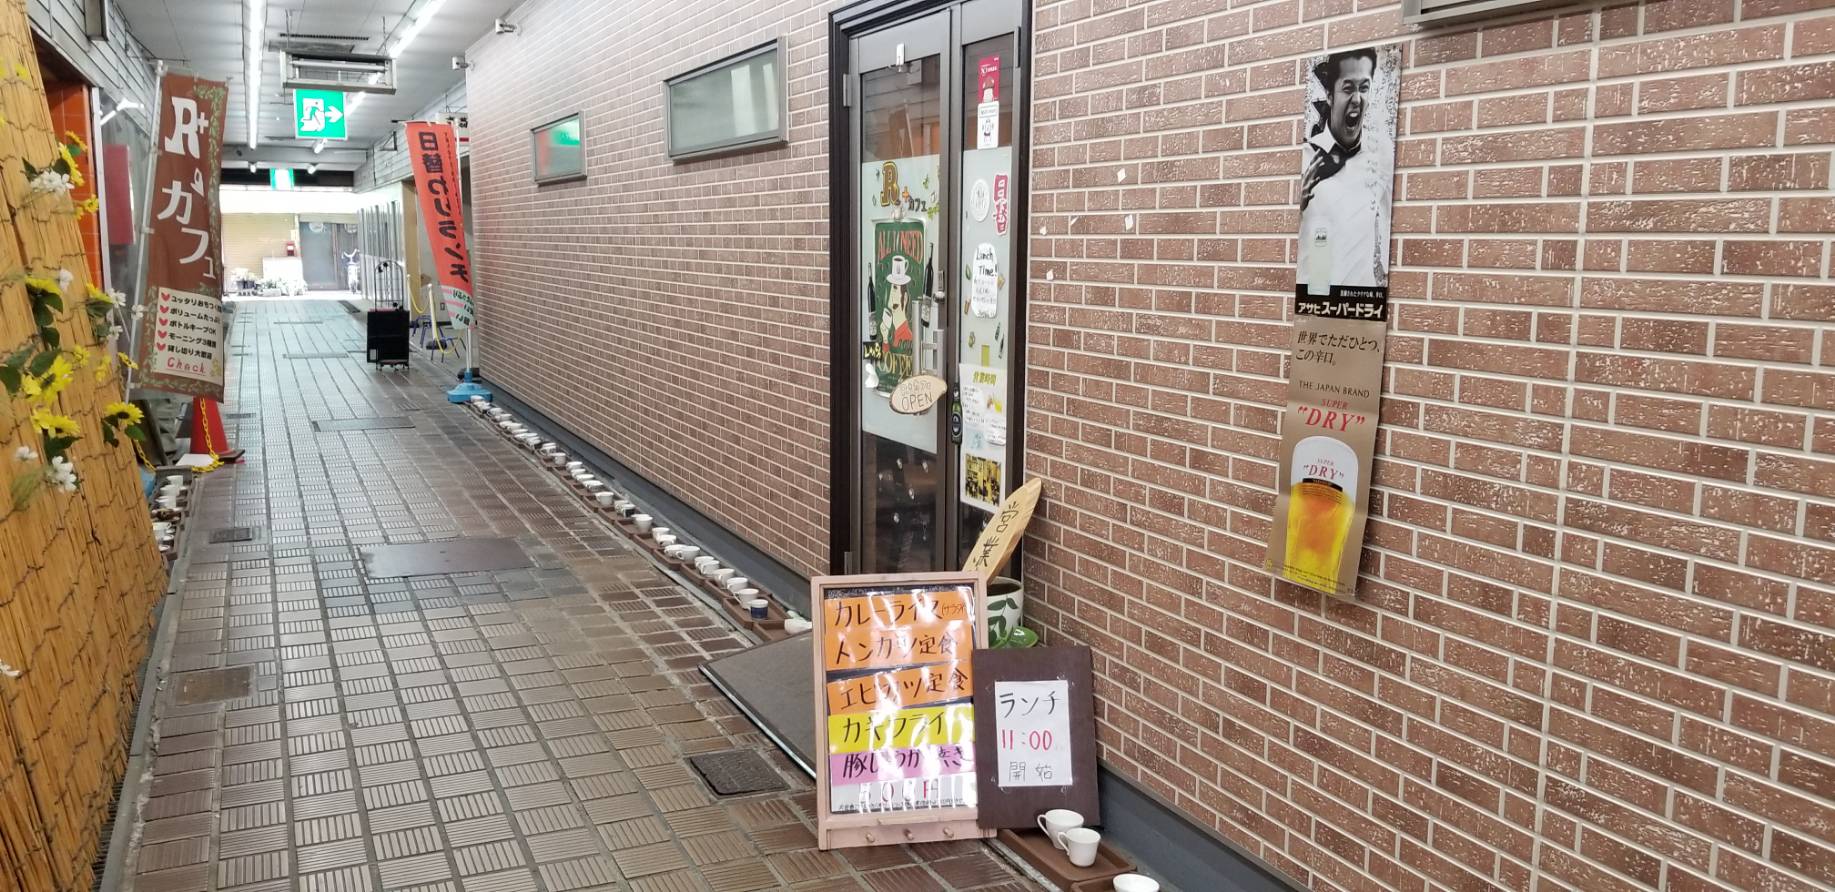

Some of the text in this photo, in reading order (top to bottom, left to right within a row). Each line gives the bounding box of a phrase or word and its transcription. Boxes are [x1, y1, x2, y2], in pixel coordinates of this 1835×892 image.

[157, 180, 216, 279] カフェ
[1298, 302, 1384, 319] アサヒスーパードライ
[1297, 330, 1380, 353] 世界でただひとつ、
[1295, 349, 1337, 366] この辛口。
[1299, 380, 1370, 399] THE JAPAN BRAND
[901, 392, 933, 411] OPEN
[1320, 399, 1348, 410] SUPER
[835, 600, 943, 628] カレーライス
[999, 690, 1065, 719] ランチ
[1001, 729, 1053, 751] 11:00
[1008, 761, 1053, 783] 開始
